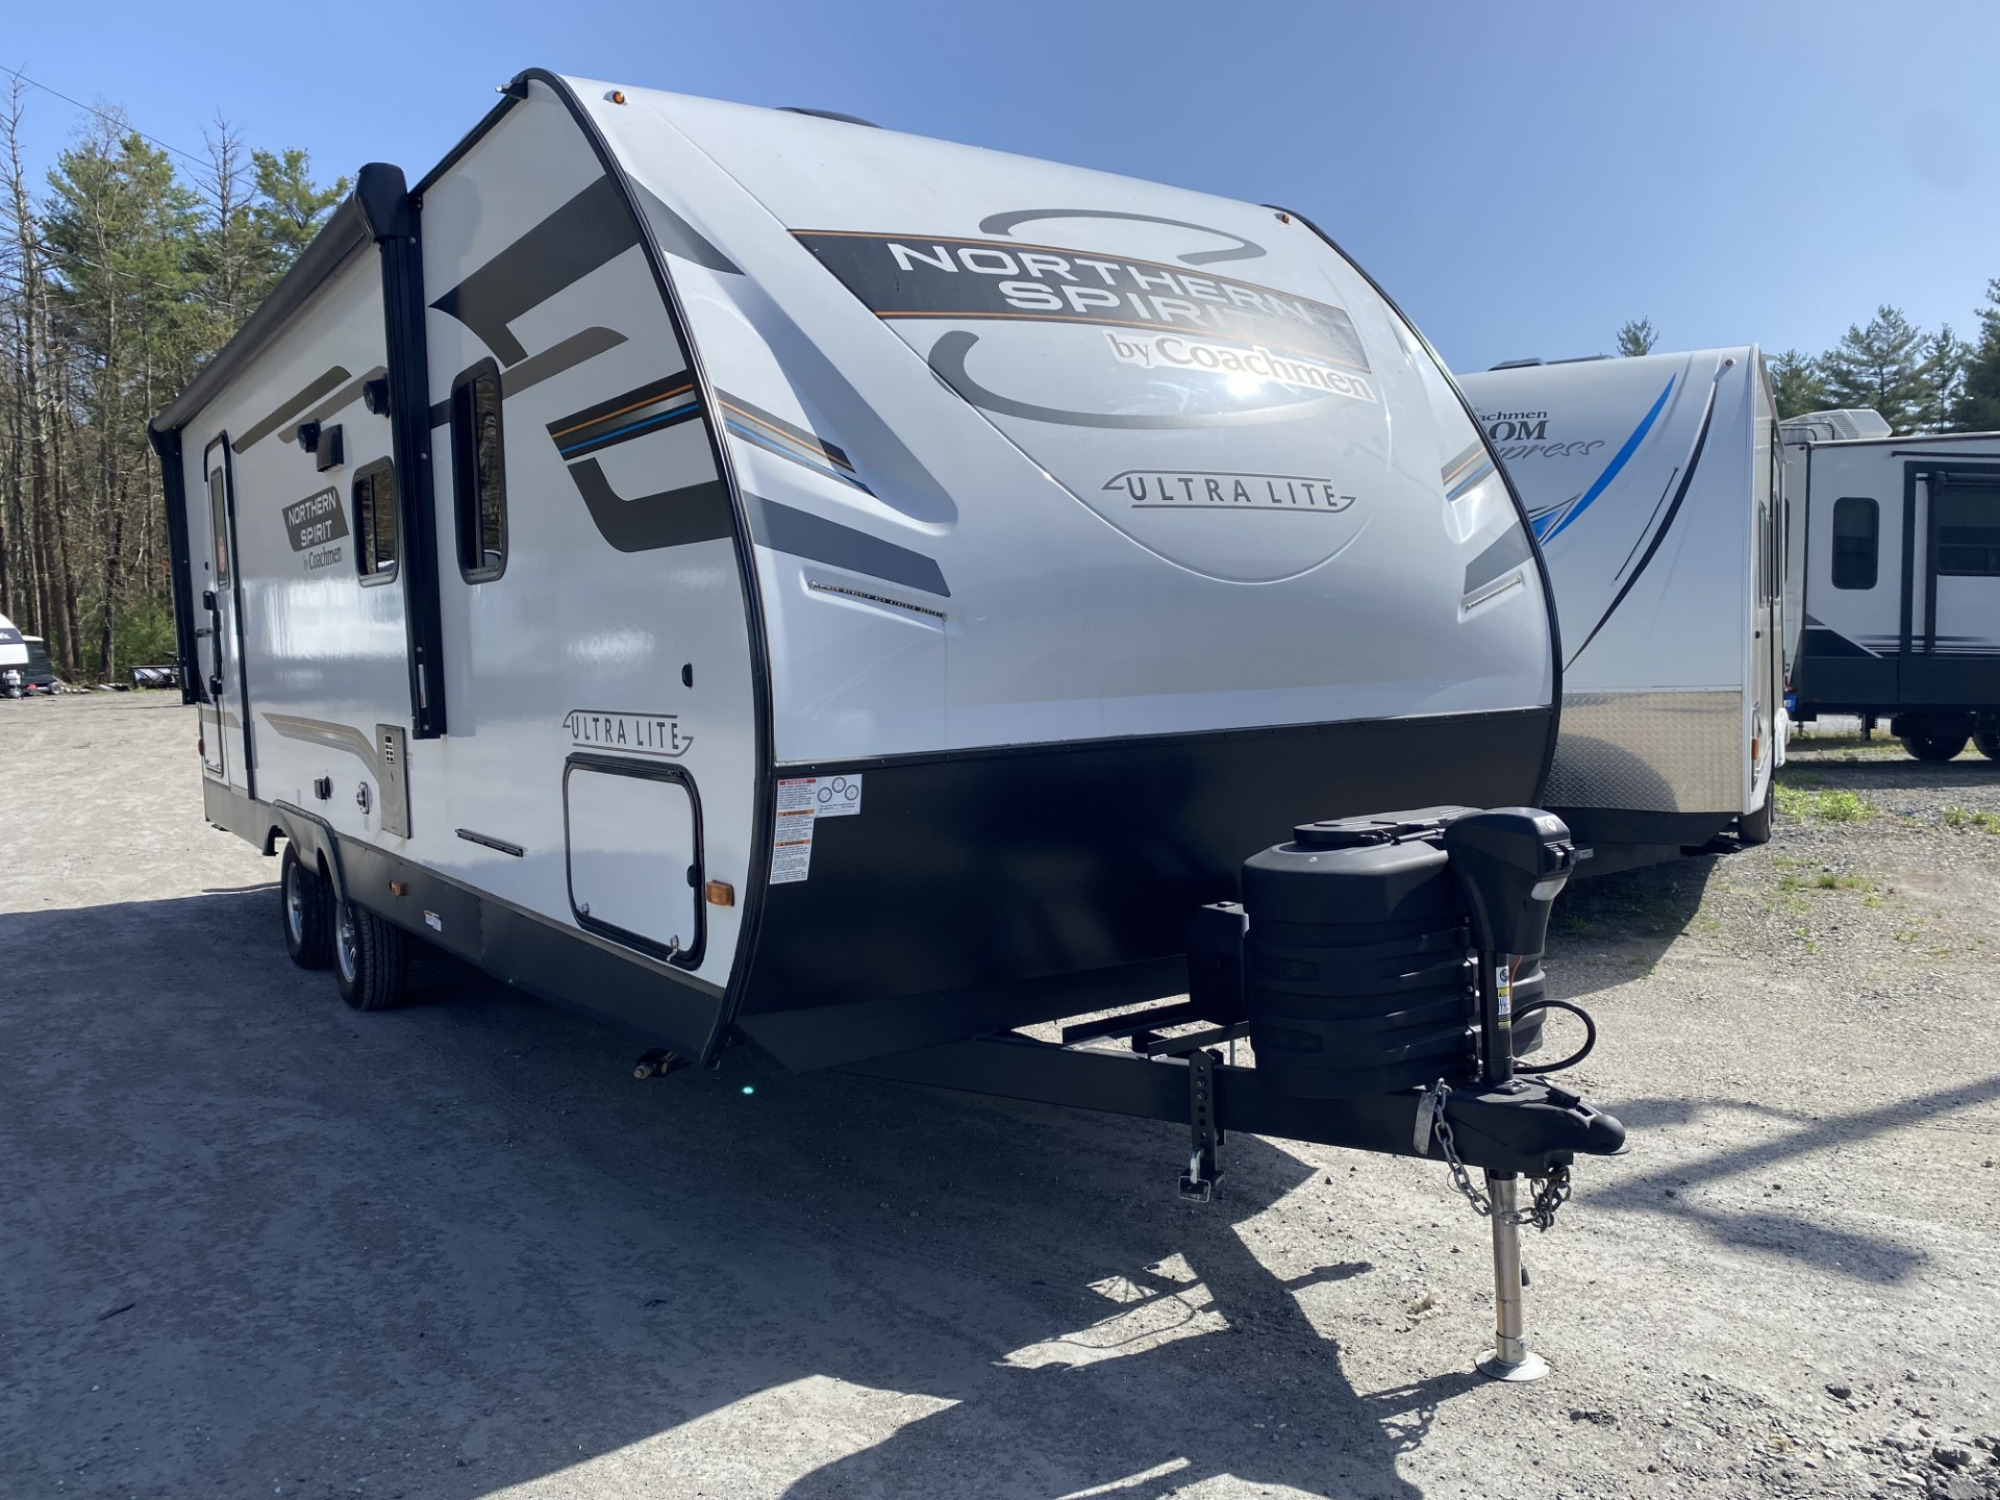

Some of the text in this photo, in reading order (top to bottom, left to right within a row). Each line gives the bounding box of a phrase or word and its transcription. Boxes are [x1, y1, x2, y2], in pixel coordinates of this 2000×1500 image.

[887, 243, 1315, 326] NORTHERN
[1108, 333, 1375, 401] by Coachmen
[288, 491, 336, 526] NORTHERN
[1126, 476, 1339, 507] ULTRA LITE
[301, 520, 332, 547] SPIRIT
[309, 546, 342, 569] Coachmen
[571, 715, 680, 750] ULTRA LITE
